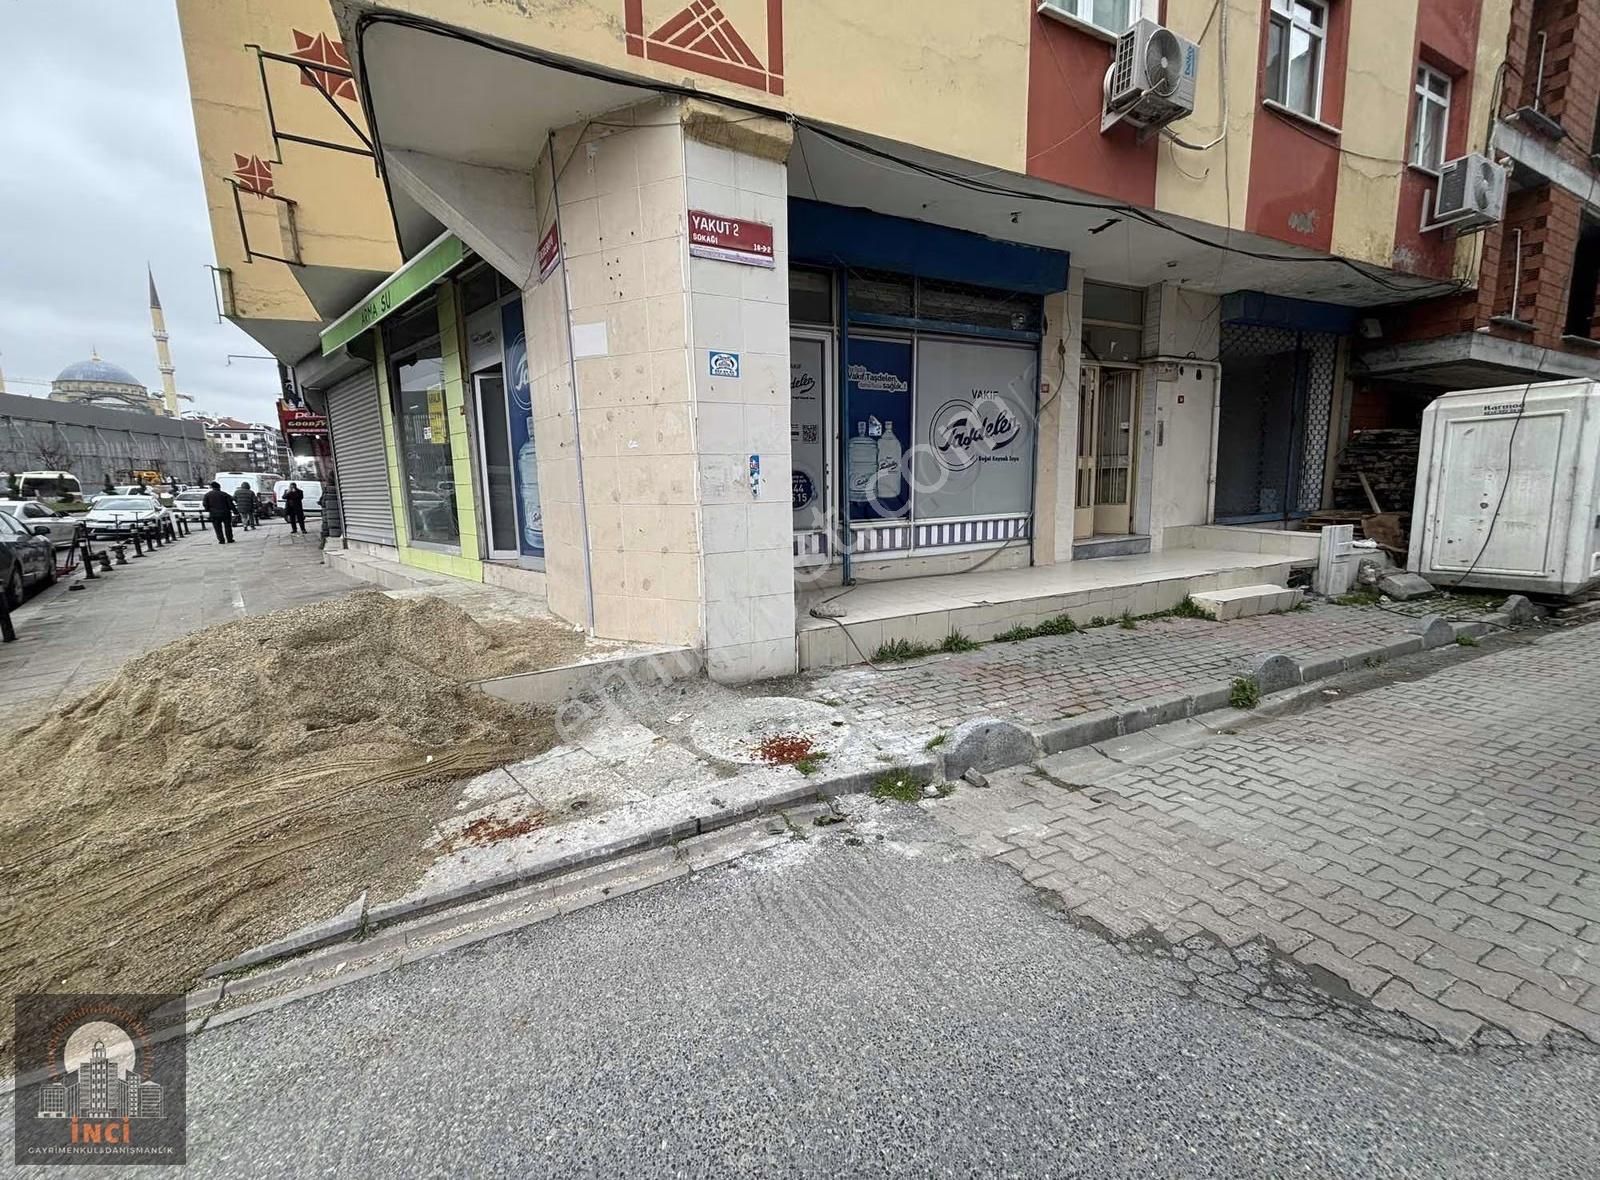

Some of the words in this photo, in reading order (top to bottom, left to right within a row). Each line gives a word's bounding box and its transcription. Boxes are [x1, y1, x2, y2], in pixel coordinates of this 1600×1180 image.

[692, 215, 731, 235] YAKUT
[733, 223, 739, 237] 2
[381, 290, 391, 313] SU
[971, 389, 999, 399] VAKIF
